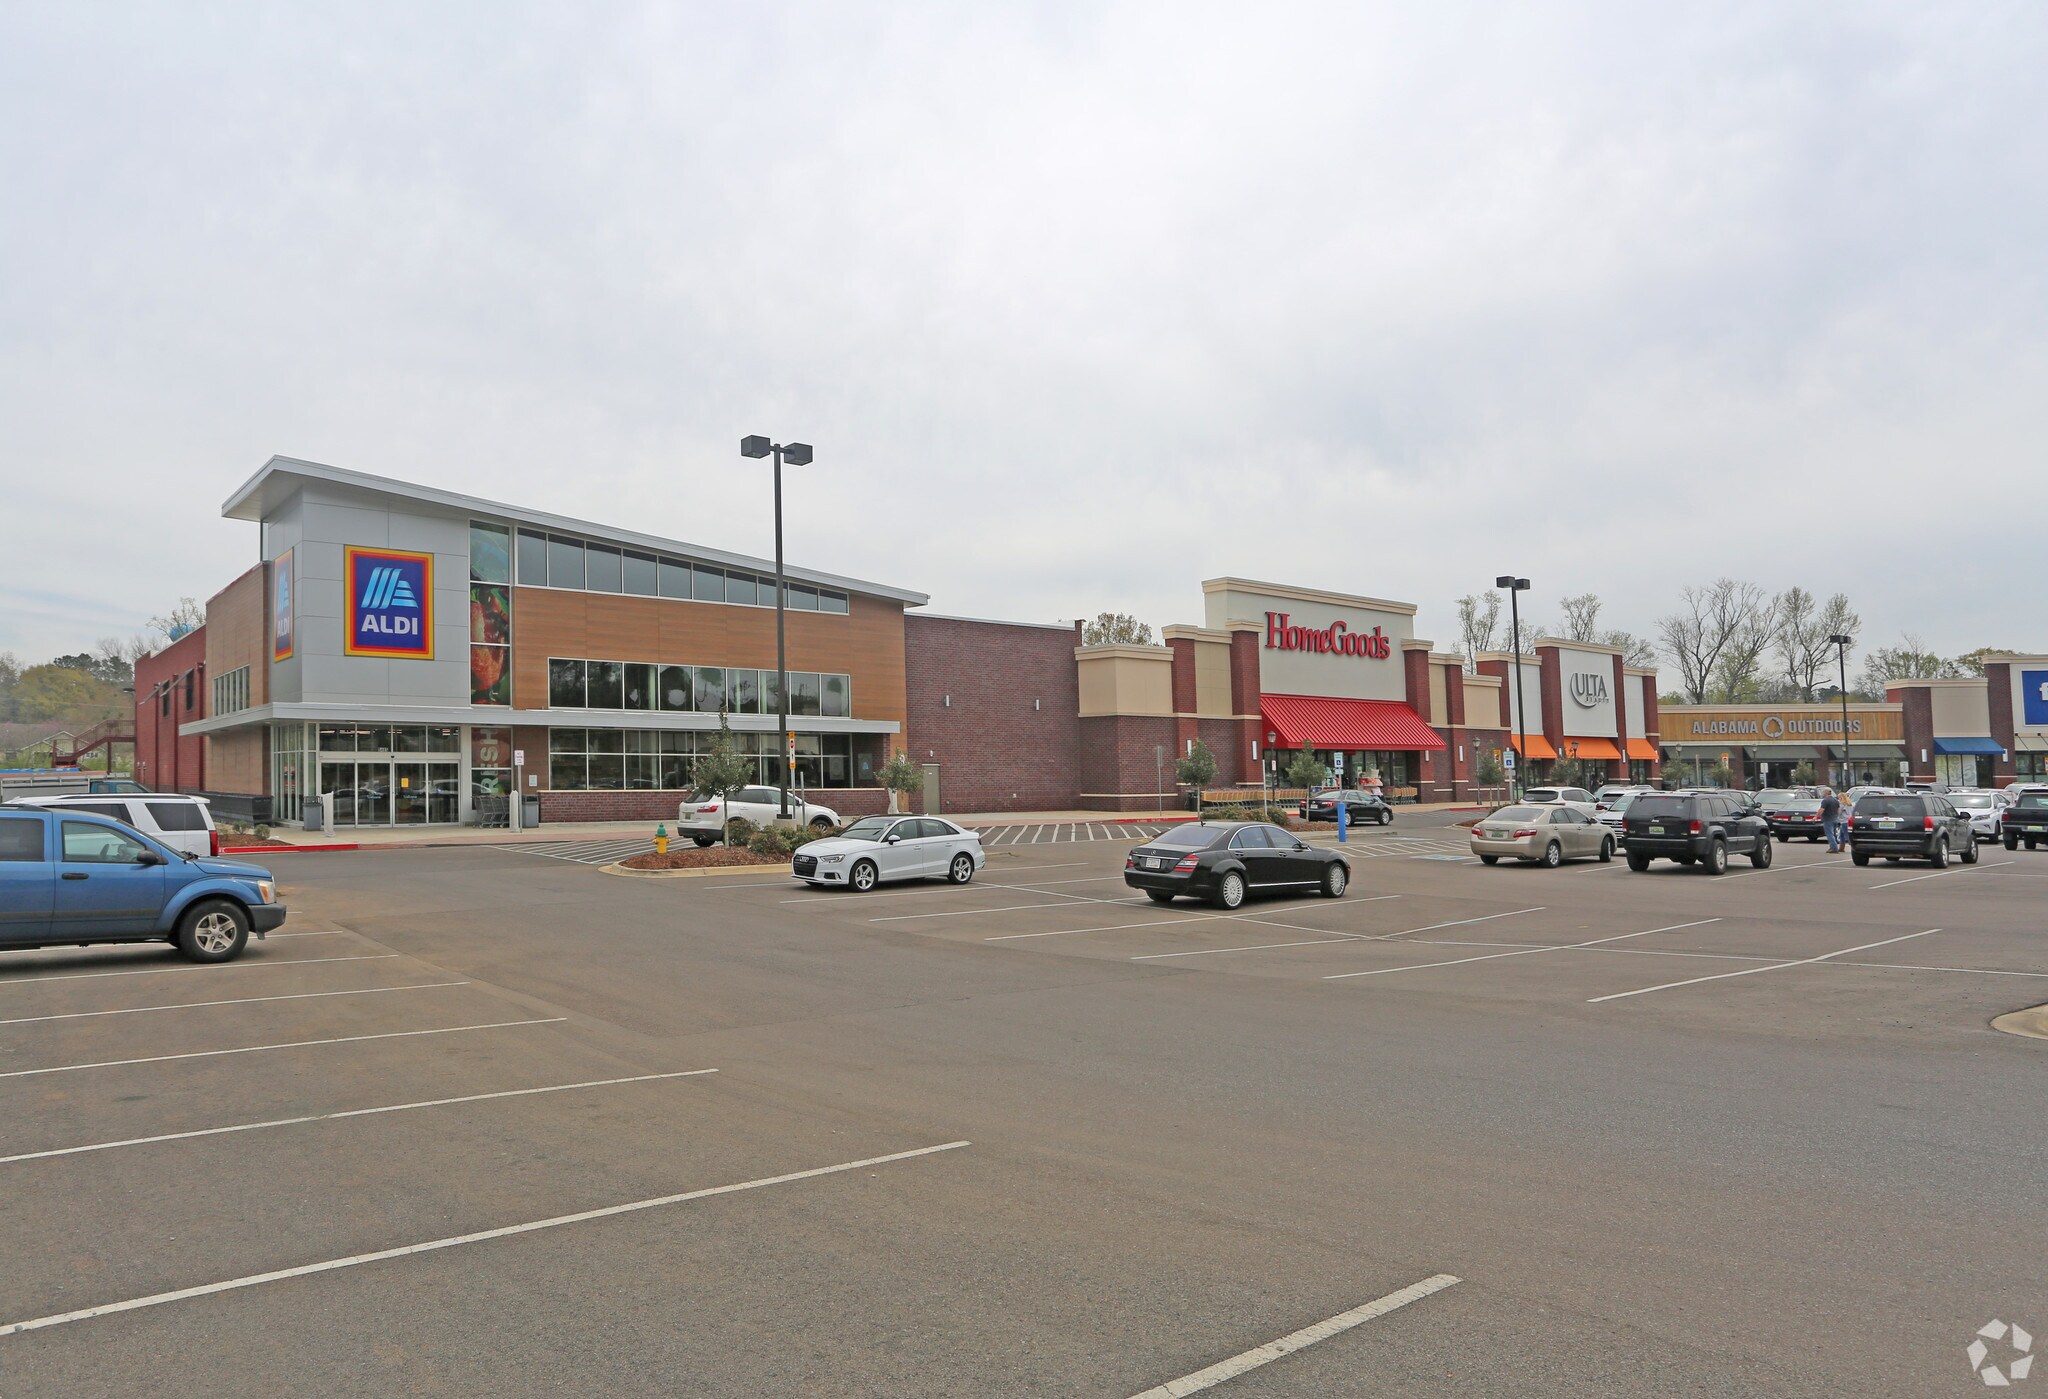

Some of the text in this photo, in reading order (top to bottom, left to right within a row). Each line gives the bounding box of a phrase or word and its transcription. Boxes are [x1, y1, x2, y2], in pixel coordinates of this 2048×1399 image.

[277, 616, 290, 638] ALDI
[361, 614, 418, 635] ALDI
[1265, 611, 1391, 659] HomeGoods
[1574, 672, 1608, 697] ULTA
[1692, 719, 1861, 734] ALABAMA OUTDOORS
[480, 728, 499, 794] RESH
